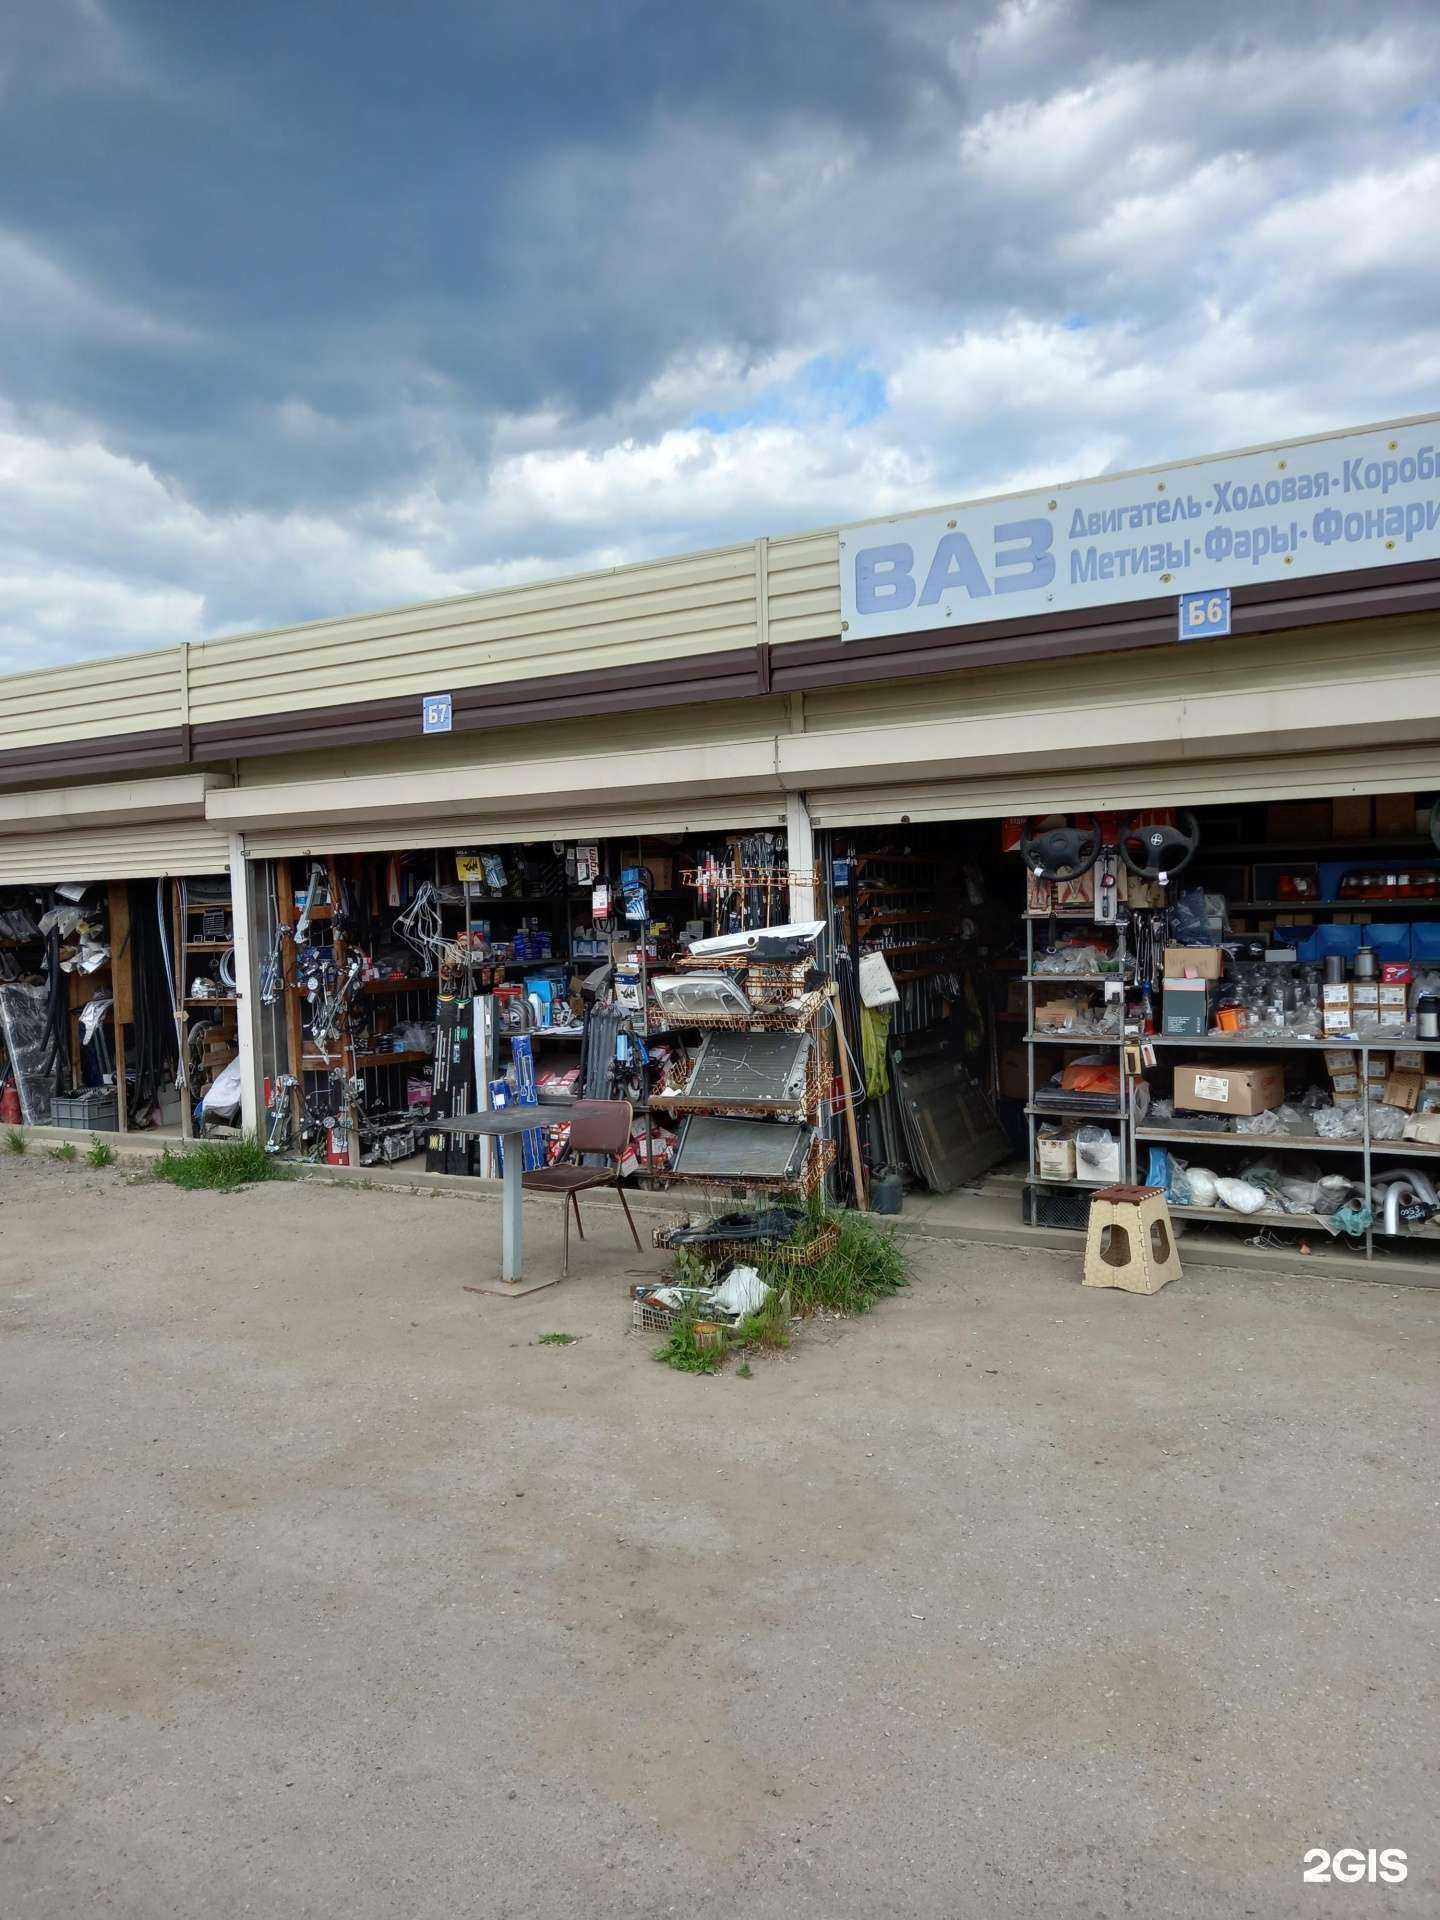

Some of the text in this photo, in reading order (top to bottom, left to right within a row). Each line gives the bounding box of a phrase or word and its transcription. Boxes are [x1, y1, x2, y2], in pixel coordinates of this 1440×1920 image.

[1068, 495, 1202, 539] Двигатель
[1213, 472, 1330, 515] Ходовая
[855, 518, 1056, 615] ВАЗ
[1070, 538, 1191, 584] Метизы
[1205, 522, 1298, 565] Фары
